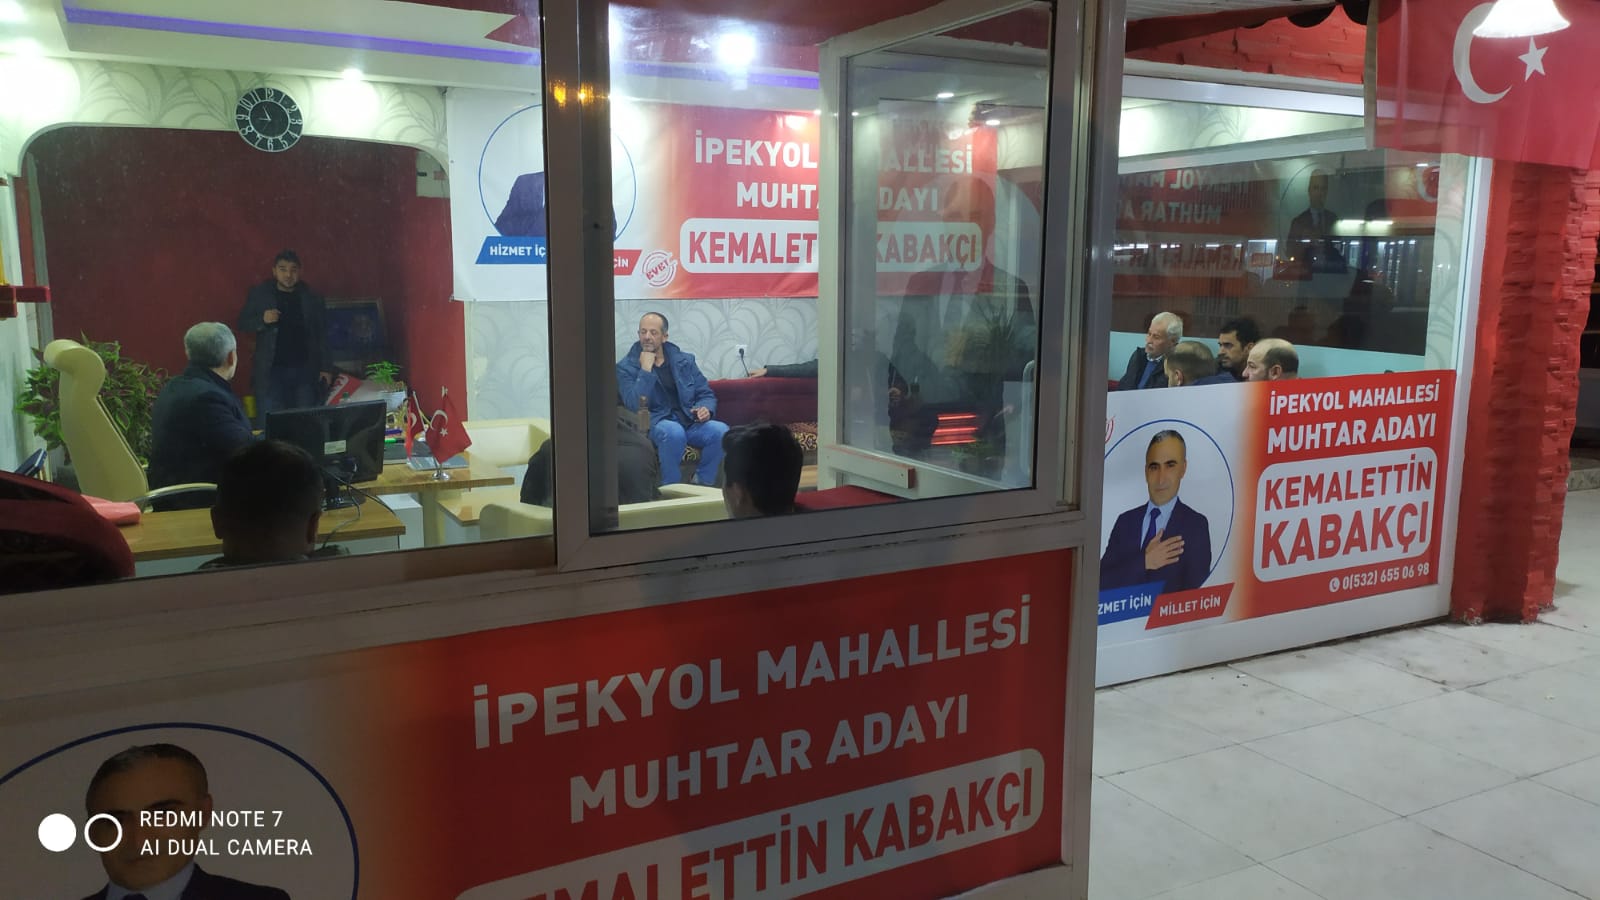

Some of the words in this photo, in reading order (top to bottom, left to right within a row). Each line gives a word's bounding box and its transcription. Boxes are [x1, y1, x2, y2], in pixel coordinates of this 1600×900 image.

[695, 129, 818, 168] İPEKYOL
[885, 143, 973, 174] ALLESİ
[736, 181, 819, 209] MUHT
[879, 187, 938, 211] DAYI
[490, 243, 533, 256] HİZMET
[535, 244, 547, 258] İÇ
[689, 231, 818, 264] KEMALET
[1269, 390, 1344, 416] İPEKYOL
[1348, 378, 1440, 409] MAHALLESİ
[1267, 419, 1367, 454] MUHTAR
[1371, 412, 1437, 444] ADAYI
[1263, 453, 1433, 512] KEMALETTİN
[1261, 501, 1429, 570] KABAKÇI
[1342, 570, 1378, 590] 0(532)
[1380, 567, 1399, 582] 655
[1402, 565, 1414, 579] 06
[1417, 562, 1430, 576] 98
[1097, 599, 1127, 615] ZMET
[1129, 593, 1152, 610] İÇİN
[1159, 600, 1198, 617] MİLLET
[1200, 594, 1221, 611] İÇİN
[472, 658, 739, 750] İPEKYOL
[757, 593, 1031, 696] MAHALLESİ
[570, 729, 812, 825] MUHTAR
[825, 693, 969, 764] ADAYI
[844, 767, 1032, 866] KABAKÇI
